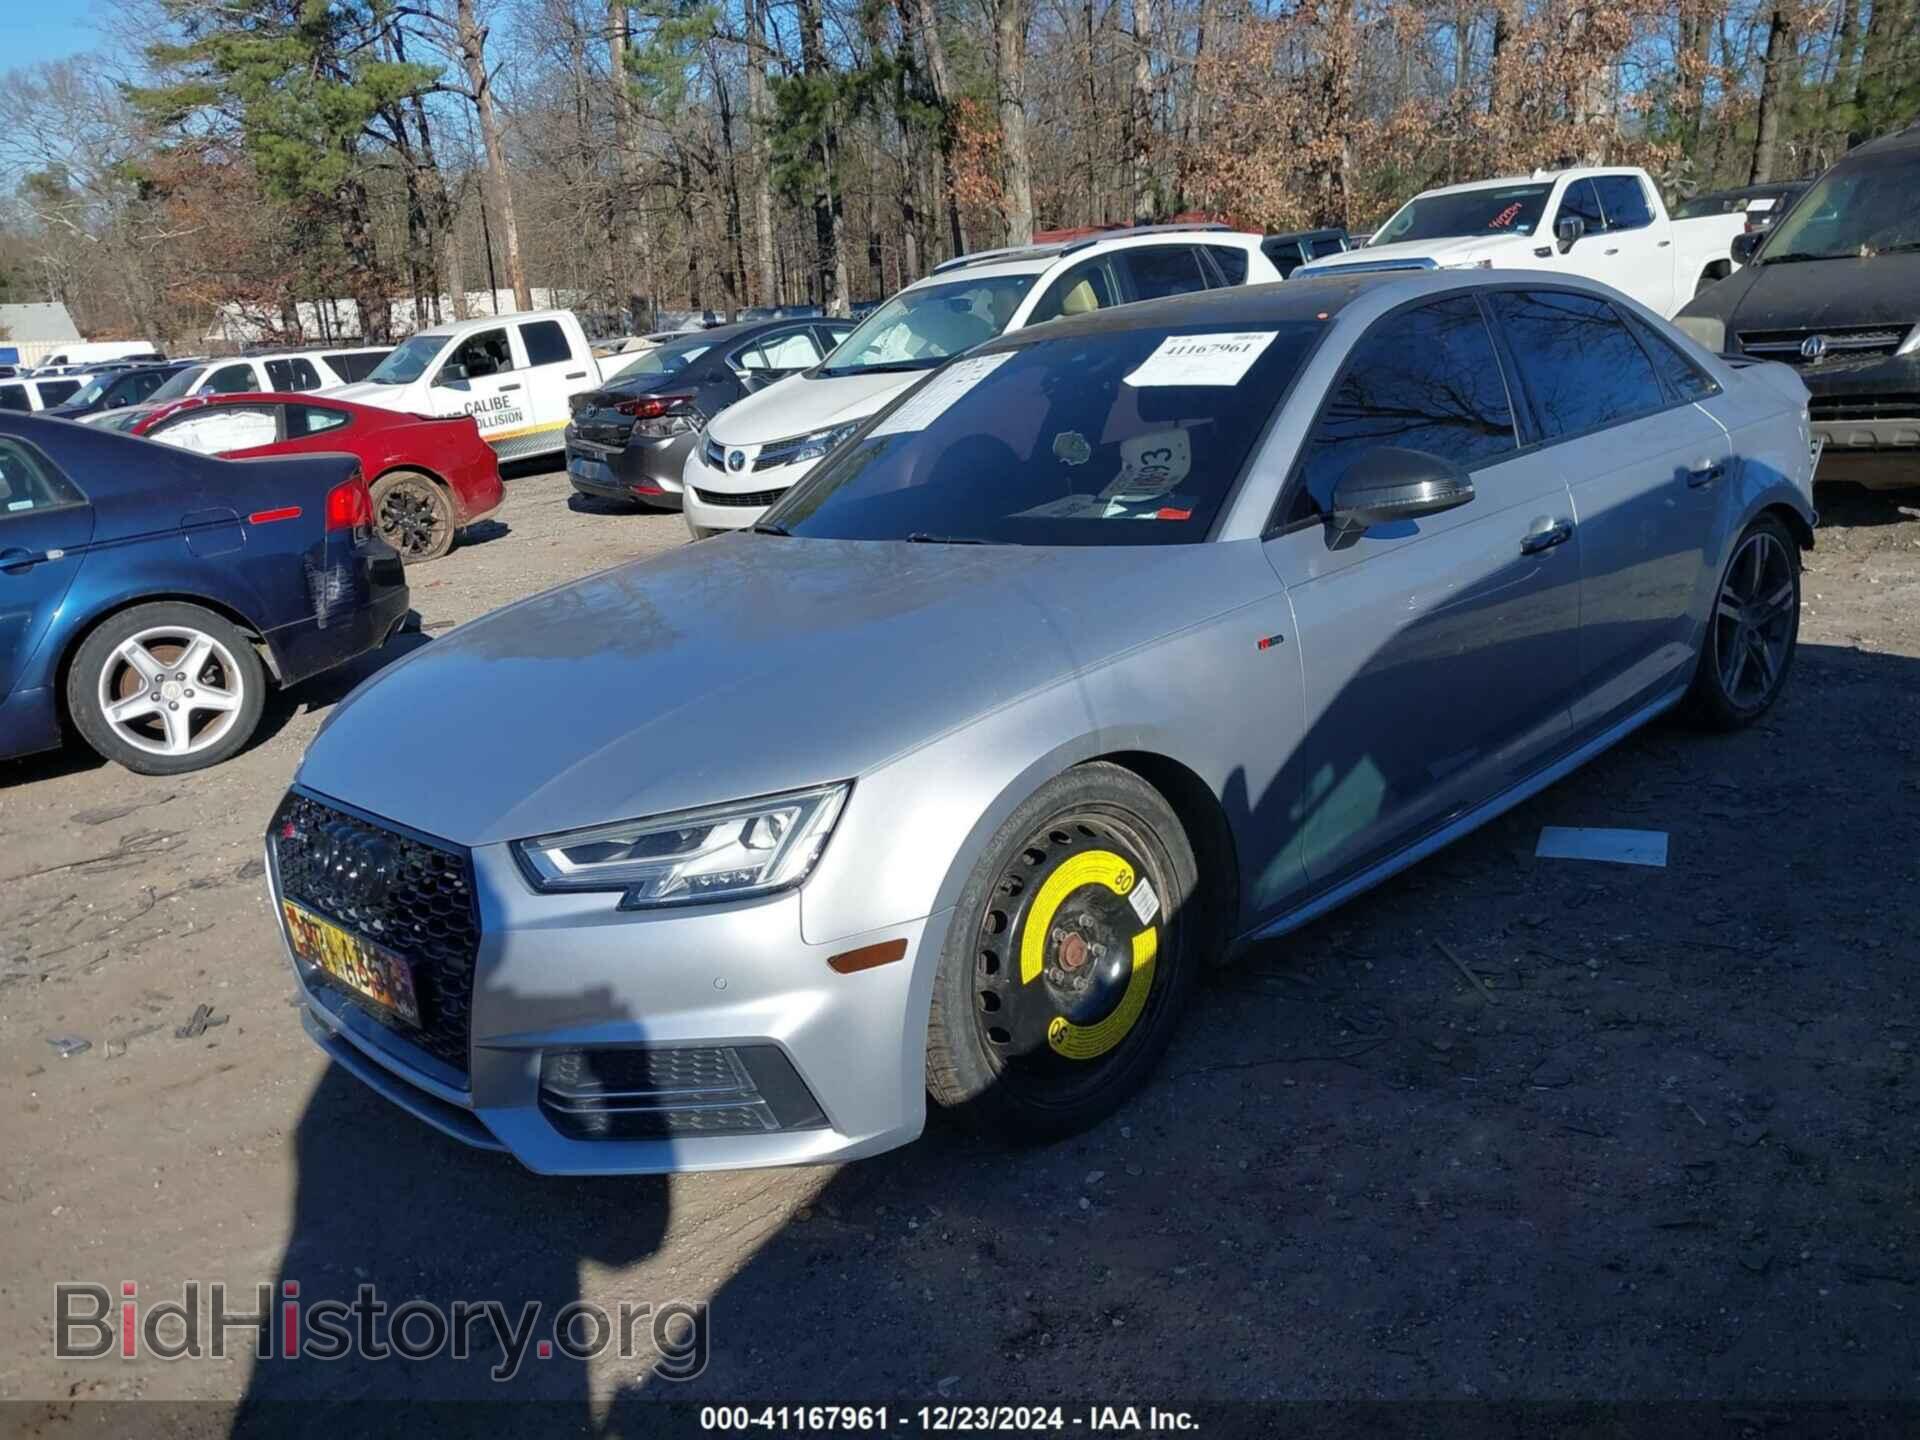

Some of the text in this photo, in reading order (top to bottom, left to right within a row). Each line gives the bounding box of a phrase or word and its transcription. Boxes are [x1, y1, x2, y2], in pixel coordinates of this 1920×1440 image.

[1165, 343, 1251, 355] 41167961
[464, 394, 511, 416] CALIBE
[476, 412, 523, 430] OLLISION
[1115, 868, 1133, 892] 80
